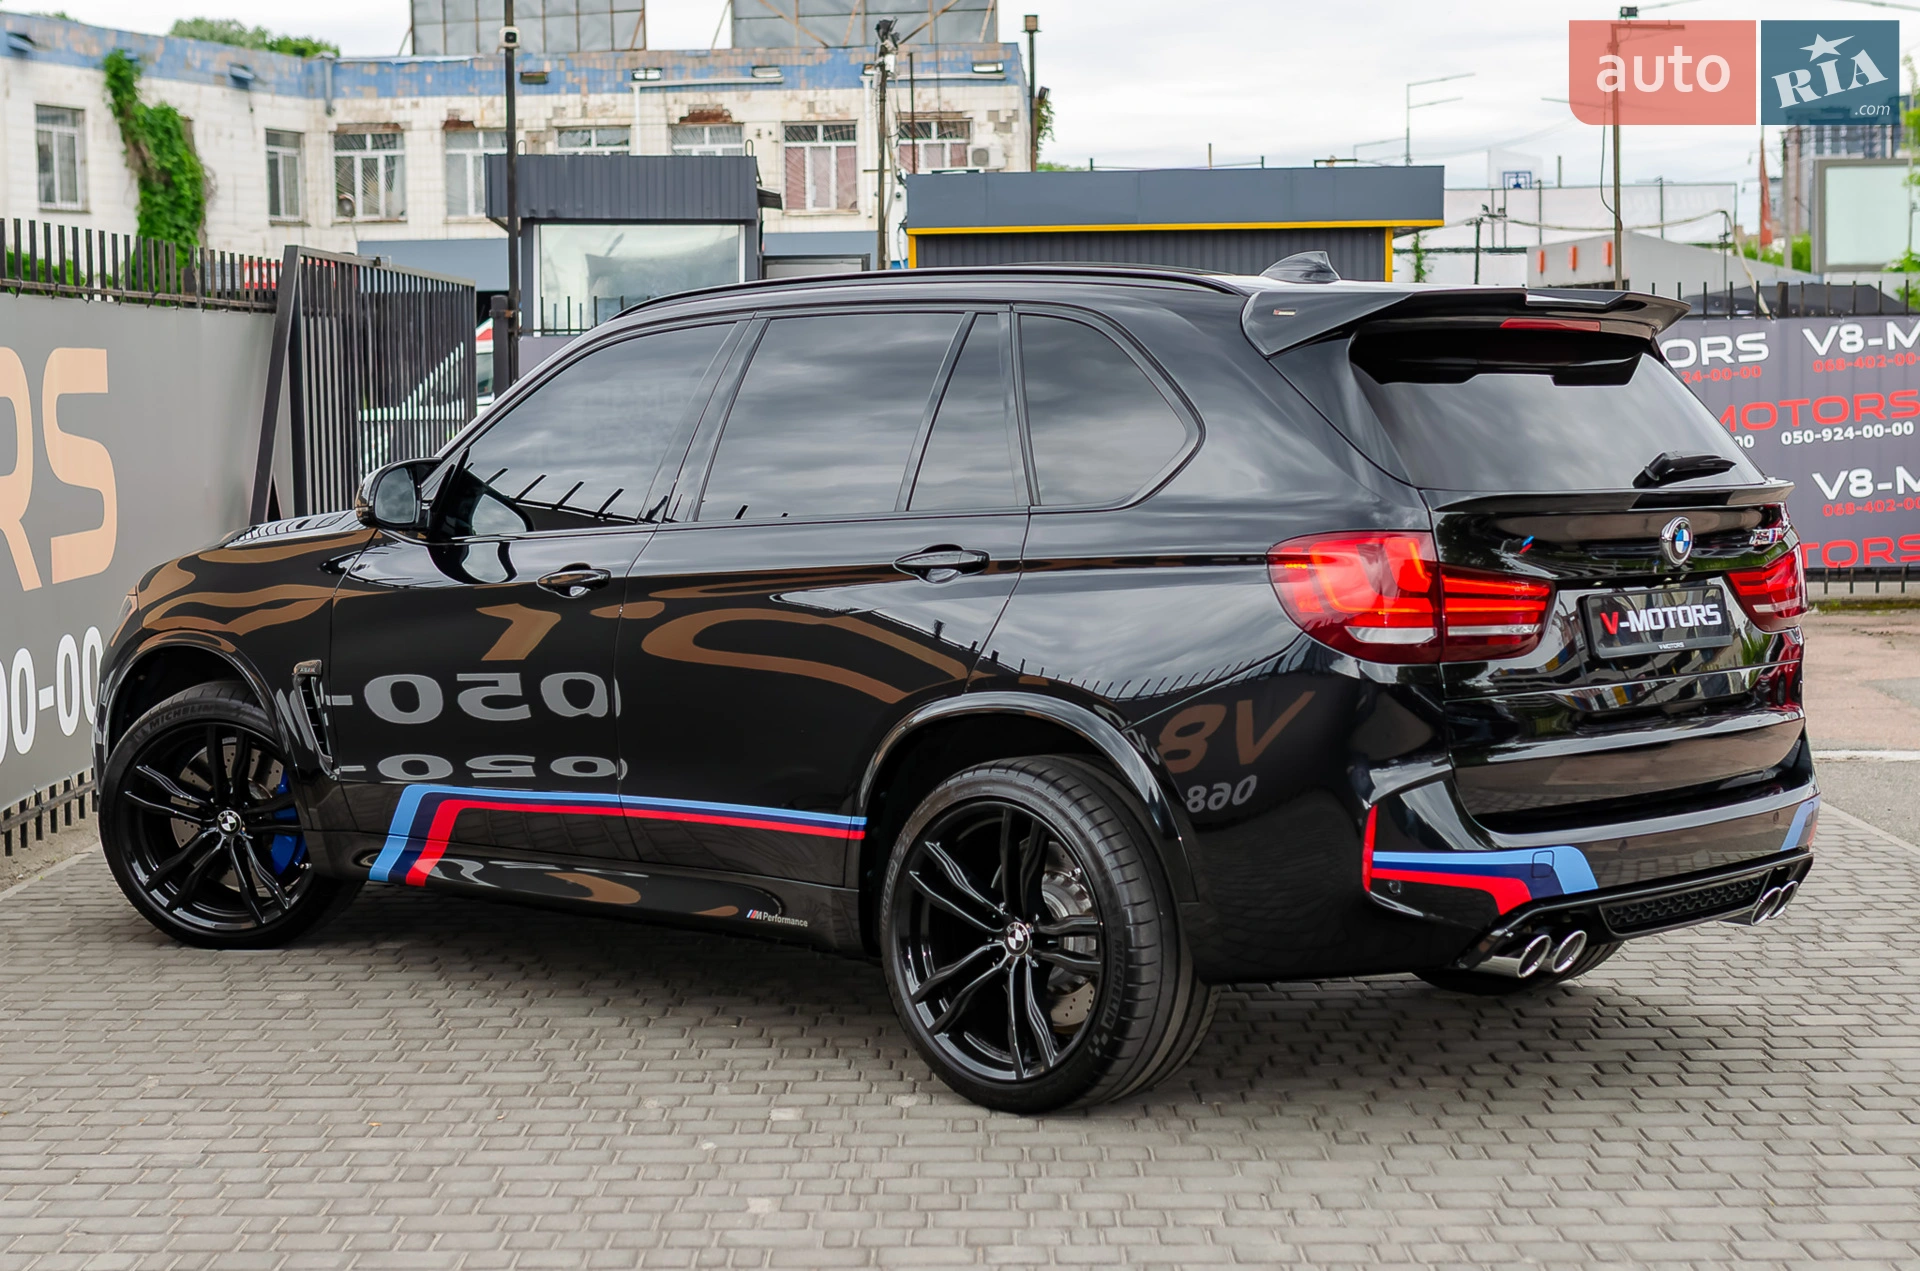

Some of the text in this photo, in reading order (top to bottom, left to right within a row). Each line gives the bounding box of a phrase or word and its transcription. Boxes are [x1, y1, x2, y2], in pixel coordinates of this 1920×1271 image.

[1660, 332, 1769, 369] ORS
[1781, 421, 1914, 446] 050-924-00-00
[1600, 603, 1722, 635] V-MOTORS
[0, 626, 104, 766] 0-00
[763, 911, 808, 927] Performance
